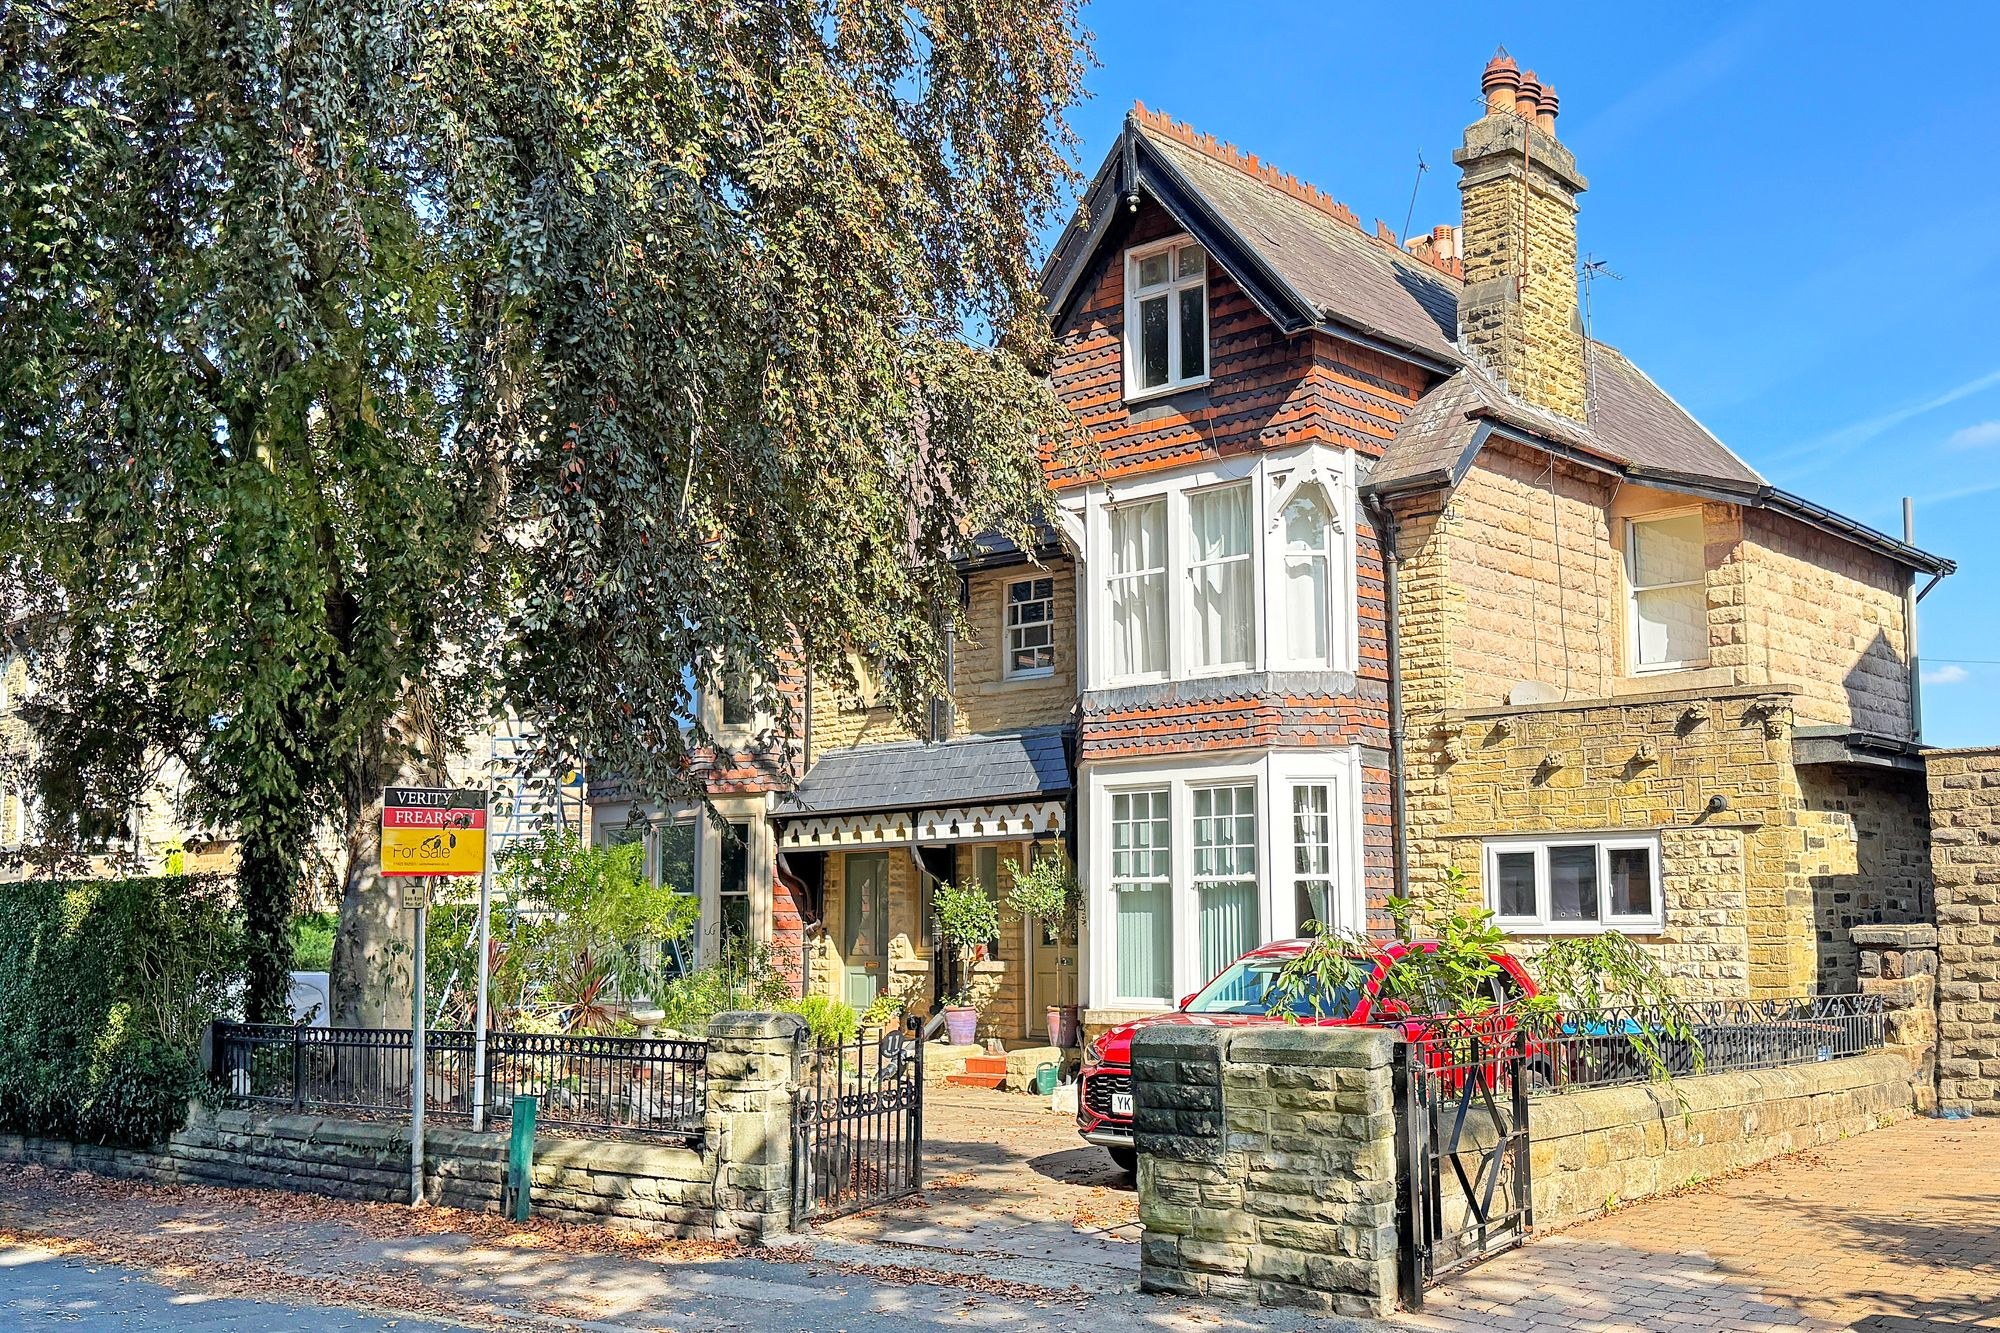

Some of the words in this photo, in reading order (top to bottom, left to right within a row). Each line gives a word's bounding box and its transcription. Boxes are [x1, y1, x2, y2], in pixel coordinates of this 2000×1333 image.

[396, 791, 452, 805] VERITY
[393, 844, 417, 859] For
[419, 844, 451, 859] Sale
[888, 1035, 900, 1050] 11
